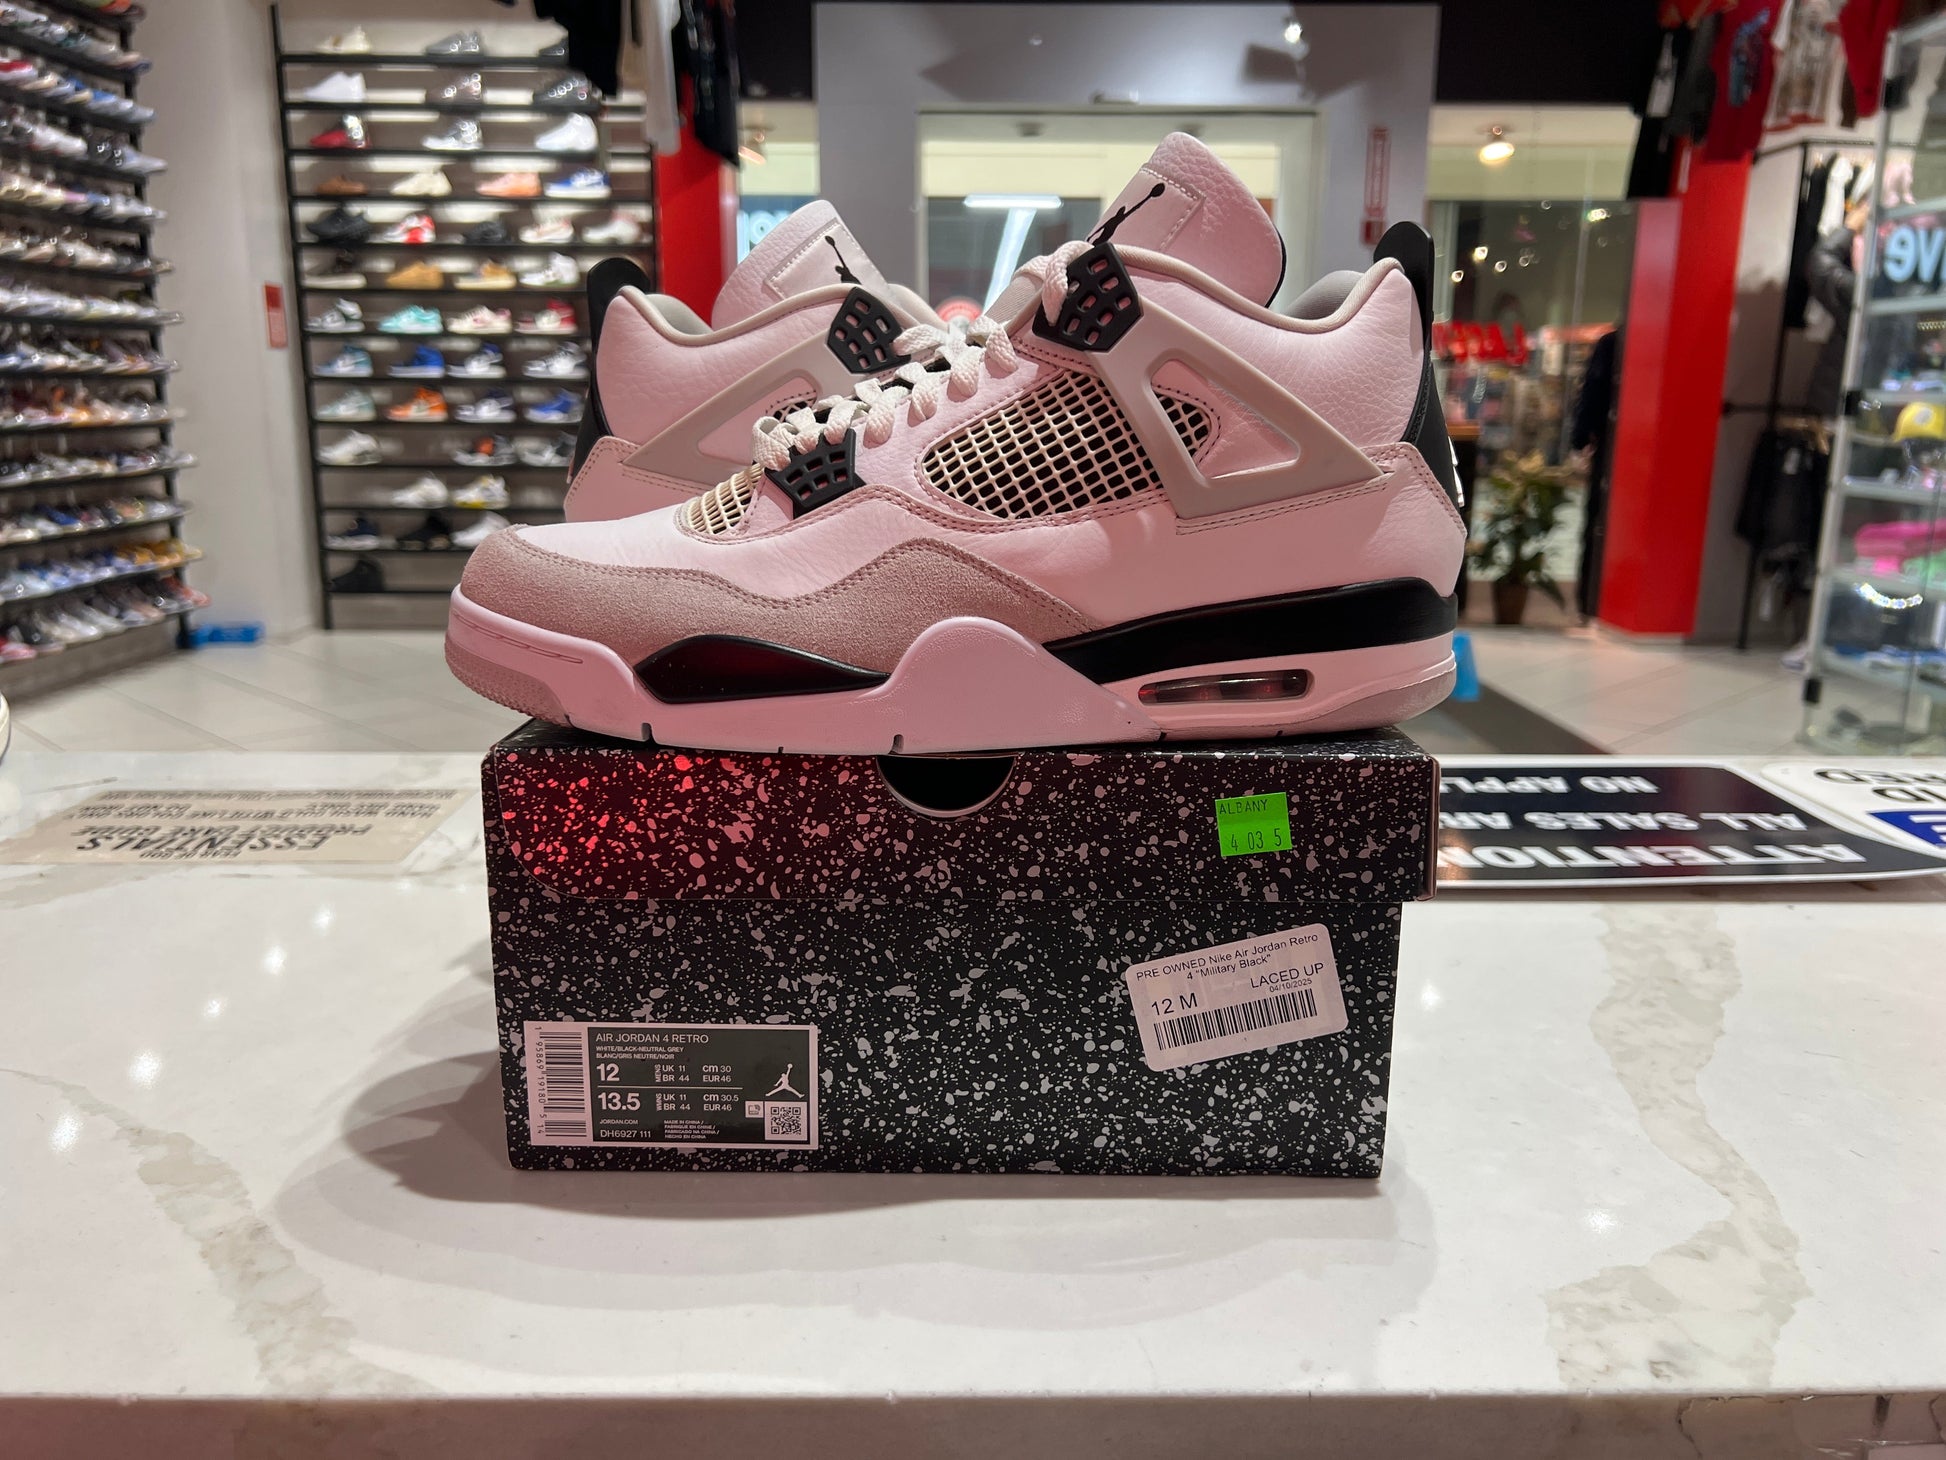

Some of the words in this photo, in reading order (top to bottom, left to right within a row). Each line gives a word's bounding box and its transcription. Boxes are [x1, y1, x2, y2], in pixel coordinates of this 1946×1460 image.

[1440, 776, 1571, 793] APPL
[1579, 776, 1661, 793] NO
[1219, 799, 1267, 815] ALBANY
[1440, 812, 1512, 830] AR
[1524, 812, 1700, 830] SALES
[1700, 813, 1807, 830] ALL
[77, 835, 330, 851] ESSENTIALS
[1247, 831, 1264, 850] 03
[1274, 828, 1282, 846] 5
[1136, 970, 1159, 981] PRE
[1162, 958, 1206, 975] OWNED
[1209, 953, 1232, 965] Nike
[1234, 949, 1249, 960] Air
[1251, 941, 1287, 957] Jordan
[1289, 934, 1318, 947] Retro
[1187, 972, 1193, 980] 4
[1250, 968, 1300, 989] LACED
[1304, 962, 1324, 977] UP
[1269, 977, 1313, 993] 04/10/2025
[1151, 998, 1175, 1016] 12
[1179, 992, 1198, 1011] M
[596, 1033, 613, 1042] AIR
[616, 1033, 660, 1043] JORDAN
[663, 1034, 669, 1043] 4
[672, 1034, 709, 1043] RETRO
[596, 1063, 620, 1082] 12
[662, 1064, 674, 1072] UK
[702, 1065, 718, 1073] cm
[720, 1065, 732, 1073] 30
[662, 1074, 675, 1082] BR
[678, 1074, 690, 1082] 44
[598, 1092, 641, 1111] 13.5
[663, 1093, 676, 1101] UK
[721, 1094, 739, 1102] 30.5
[663, 1103, 676, 1111] BR
[600, 1130, 637, 1138] DH6927
[639, 1130, 651, 1138] 111
